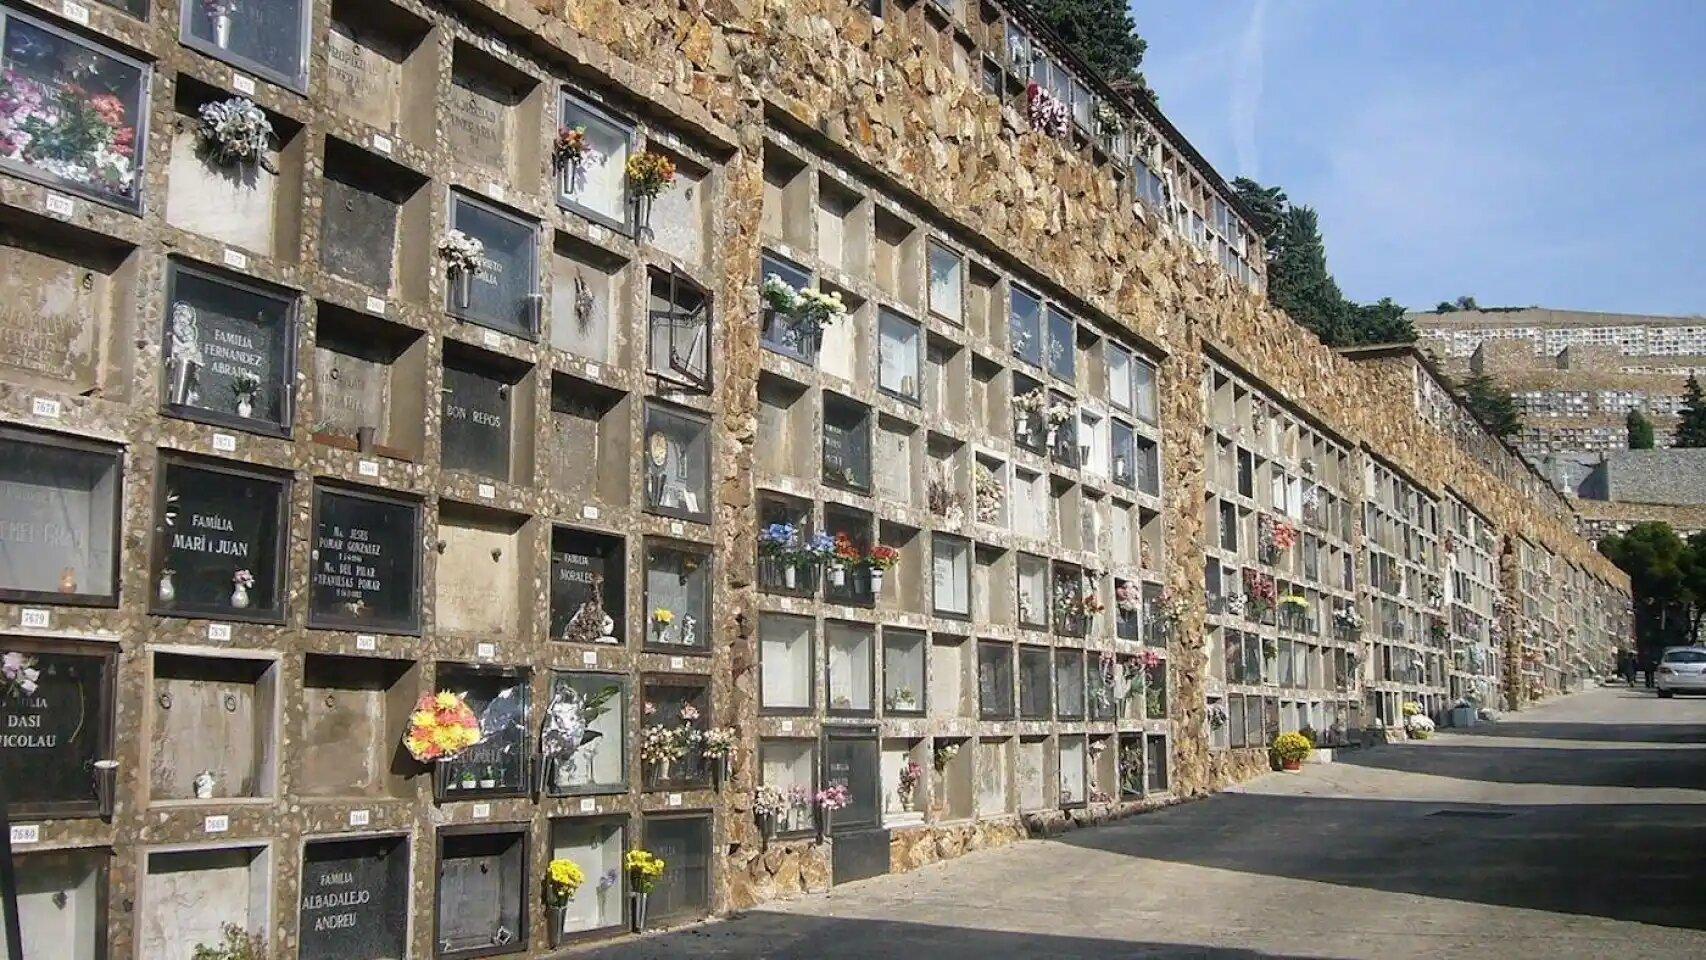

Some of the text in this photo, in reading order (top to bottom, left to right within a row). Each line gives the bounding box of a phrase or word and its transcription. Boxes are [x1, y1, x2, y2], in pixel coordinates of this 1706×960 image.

[204, 344, 262, 366] FERNANDEZ
[447, 405, 500, 428] BON REPOS
[172, 534, 205, 552] MARÍ
[216, 540, 248, 557] JUAN
[347, 541, 381, 556] GONZALEZ
[8, 714, 41, 728] DASI
[321, 872, 353, 887] FAMILIA
[302, 890, 370, 910] ALBADALEJO
[315, 912, 357, 932] ANDREU
